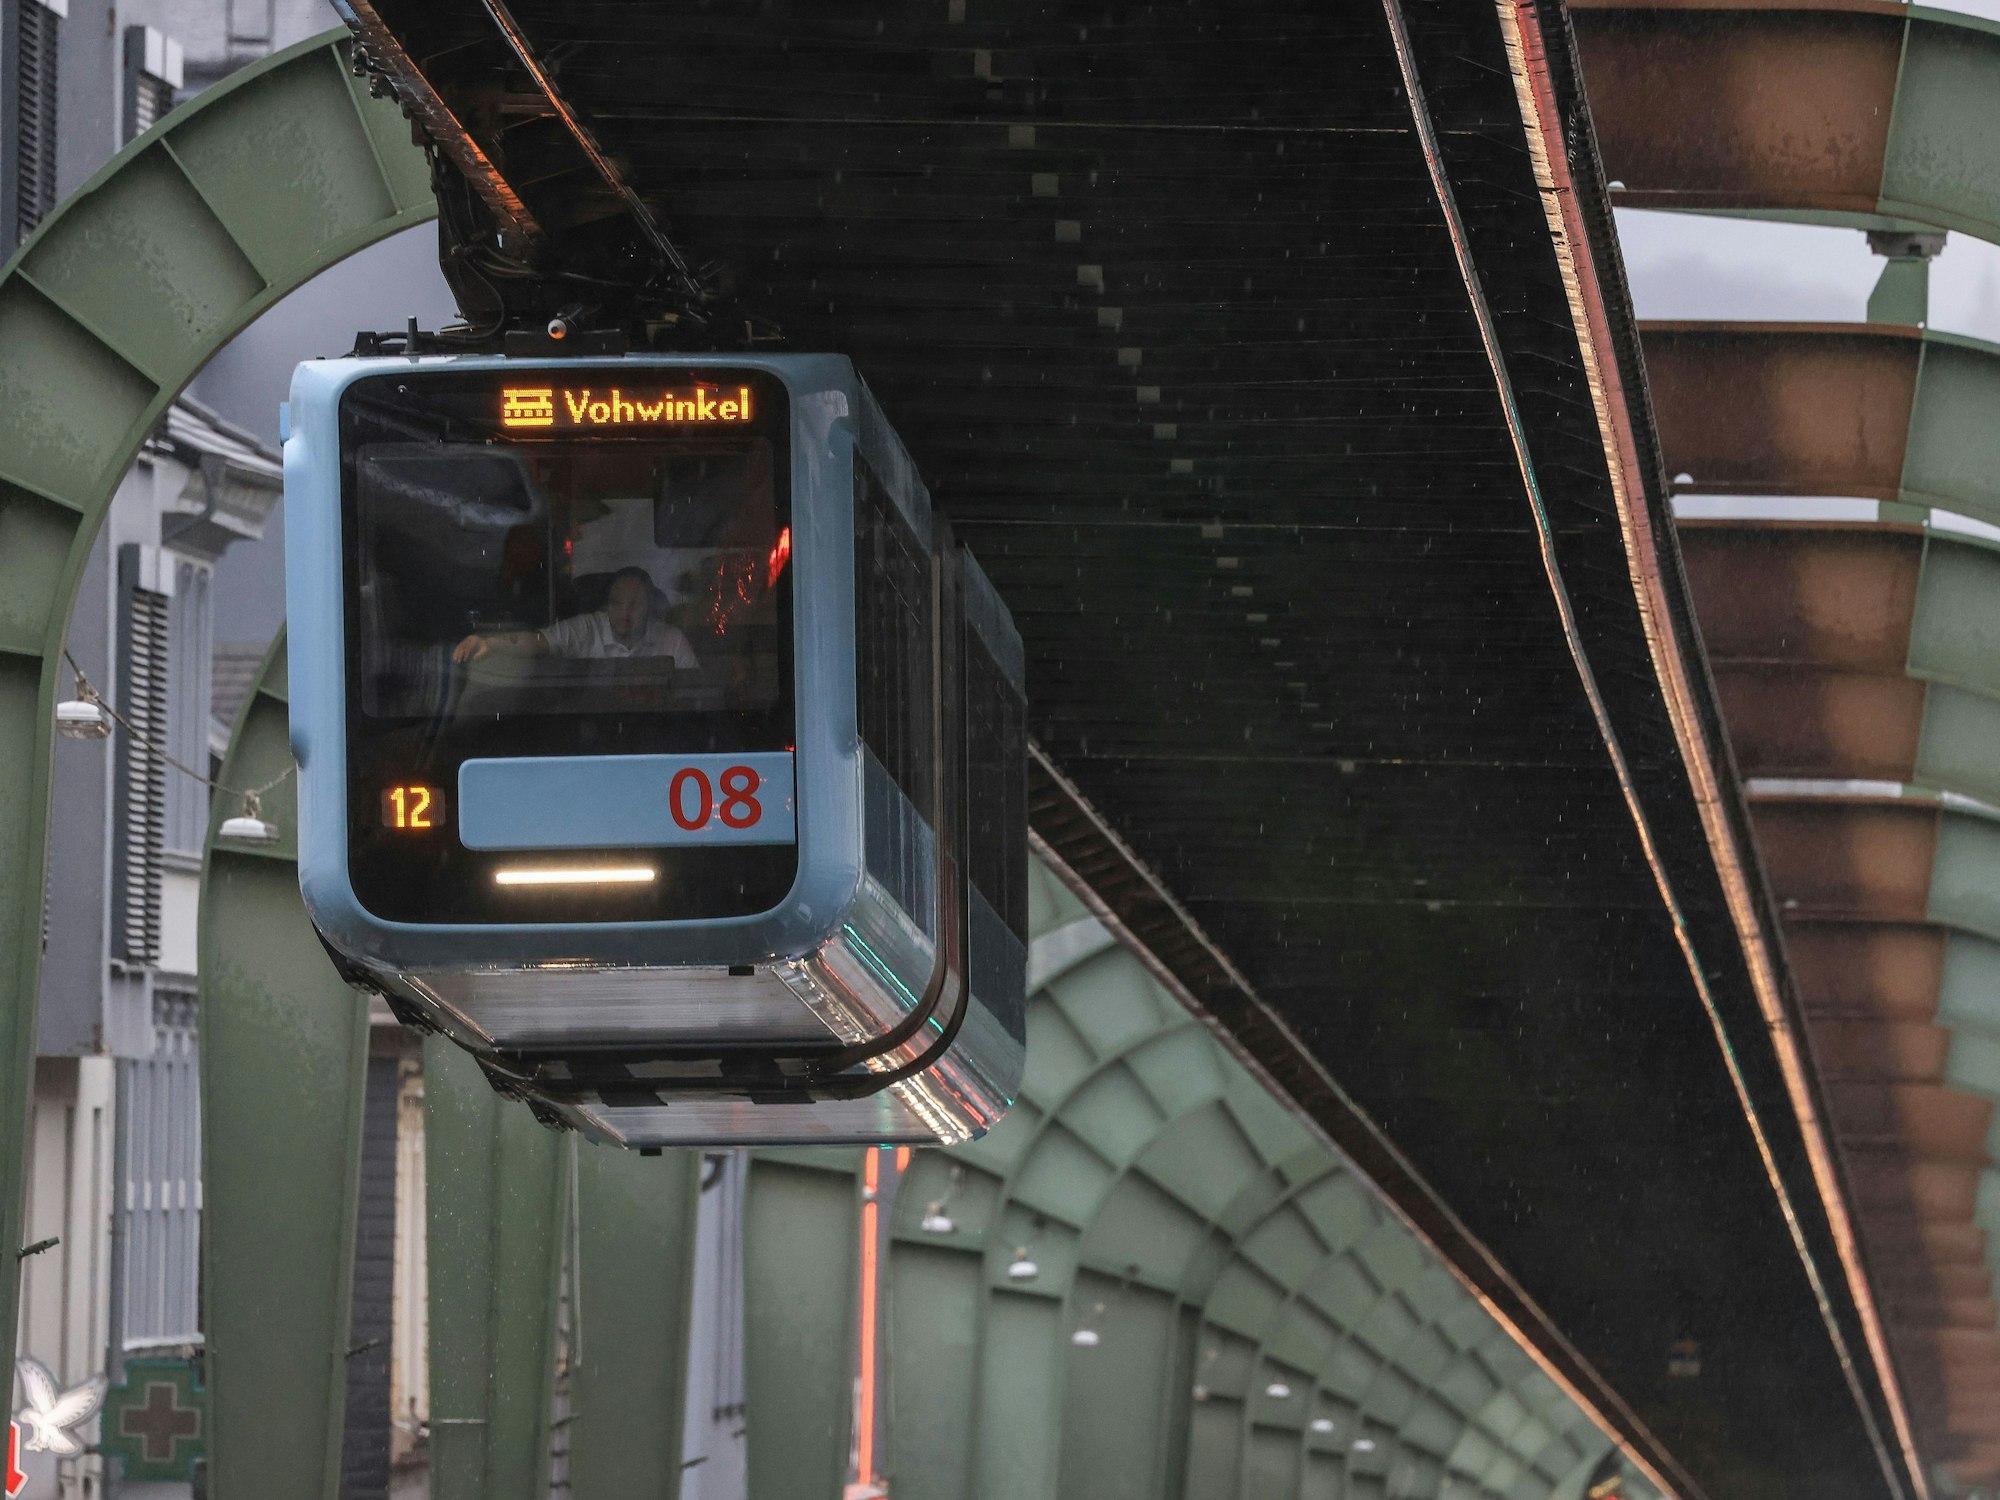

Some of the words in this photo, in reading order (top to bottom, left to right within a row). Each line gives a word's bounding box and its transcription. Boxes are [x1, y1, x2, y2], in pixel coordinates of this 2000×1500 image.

[564, 388, 749, 424] Vohwinkel
[389, 786, 432, 828] 12
[669, 765, 762, 831] 08
